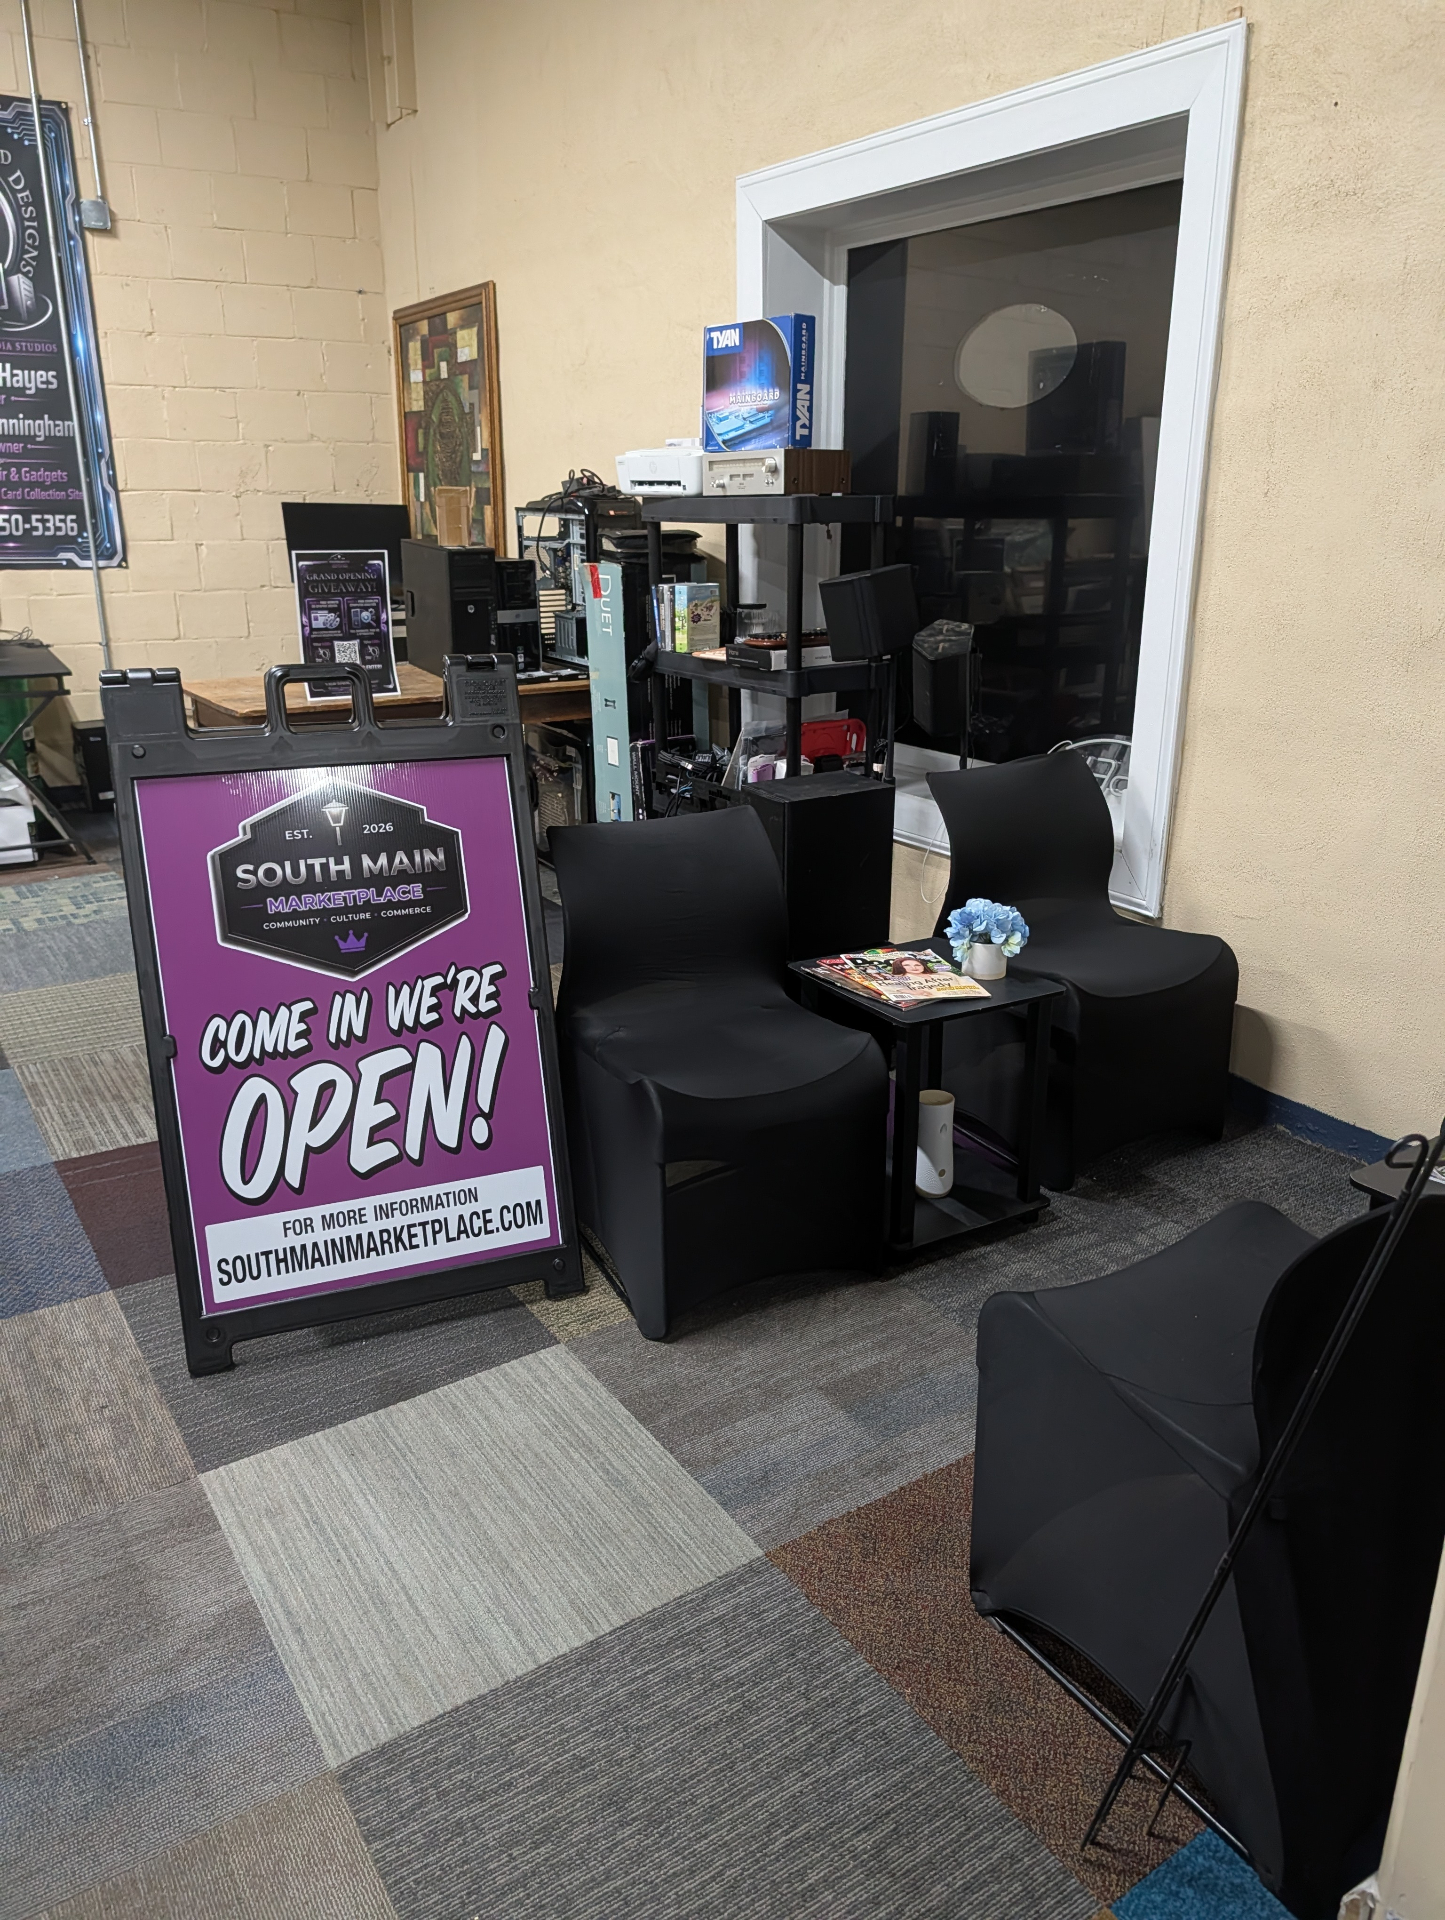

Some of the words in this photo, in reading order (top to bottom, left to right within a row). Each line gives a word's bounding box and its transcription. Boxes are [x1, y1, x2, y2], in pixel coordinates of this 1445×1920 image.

[8, 169, 39, 277] DESIGNS
[0, 341, 13, 351] IA
[15, 341, 58, 353] STUDIOS
[710, 328, 740, 349] TYAN
[0, 363, 58, 394] Hayes
[729, 390, 780, 404] MAINBOARD
[796, 383, 811, 440] TYAN
[10, 467, 19, 481] &
[21, 467, 68, 485] Gadgets
[1, 488, 22, 500] Card
[24, 488, 66, 500] Collection
[0, 514, 78, 536] 50-5356
[306, 573, 338, 581] GRAND
[338, 572, 377, 580] OPENING
[308, 581, 377, 593] GIVEAWAY!
[599, 574, 613, 636] DUET
[285, 829, 313, 840] EST.
[363, 822, 394, 834] 2026
[236, 857, 351, 889] SOUTH
[361, 847, 447, 878] MAIN
[266, 883, 424, 914] MARKETPLACE
[263, 917, 321, 930] COMMUNITY
[330, 912, 372, 923] CULTURE
[380, 905, 432, 918] COMMERCE
[876, 977, 923, 988] Healing
[924, 976, 954, 985] After
[201, 999, 316, 1070] COME
[326, 989, 371, 1045] IN
[386, 963, 505, 1033] WE'RE
[220, 1023, 507, 1202] OPEN!
[282, 1217, 315, 1238] FOR
[321, 1206, 368, 1232] MORE
[373, 1186, 479, 1222] INFORMATION
[216, 1199, 544, 1287] SOUTHMAINMARKETPLACE.COM
